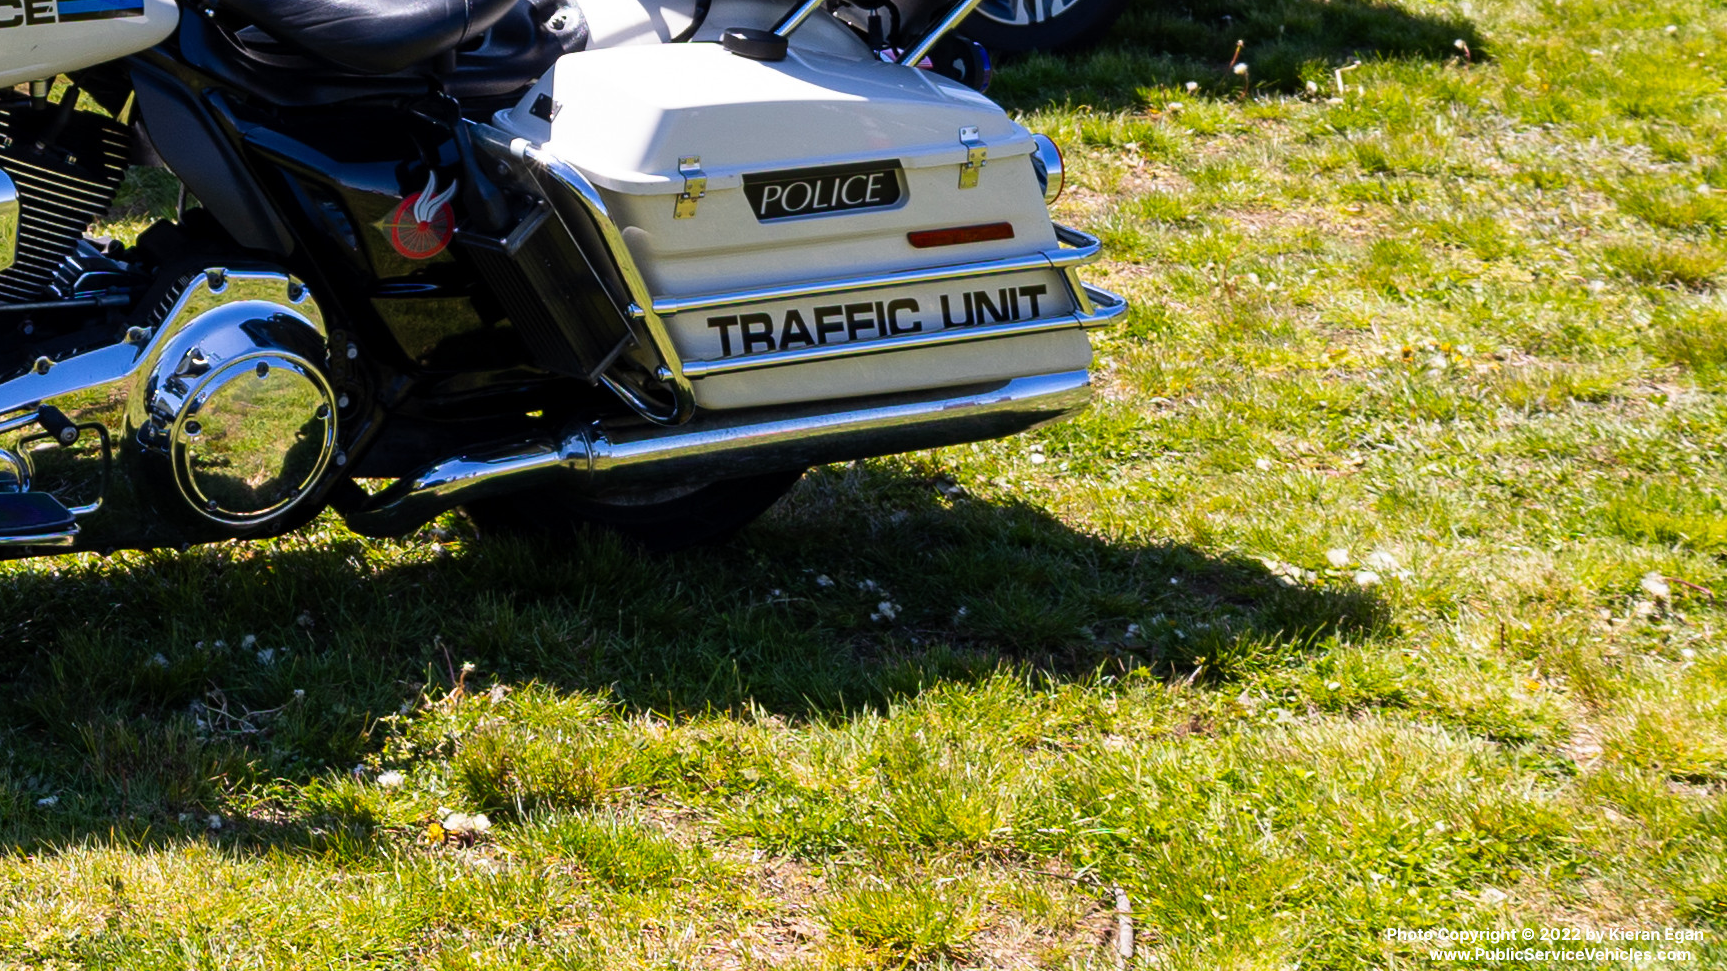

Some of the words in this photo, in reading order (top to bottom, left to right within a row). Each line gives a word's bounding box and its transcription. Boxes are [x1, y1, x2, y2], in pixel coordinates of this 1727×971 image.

[761, 173, 884, 215] POLICE
[707, 297, 922, 357] TRAFFIC
[939, 284, 1048, 329] UNIT
